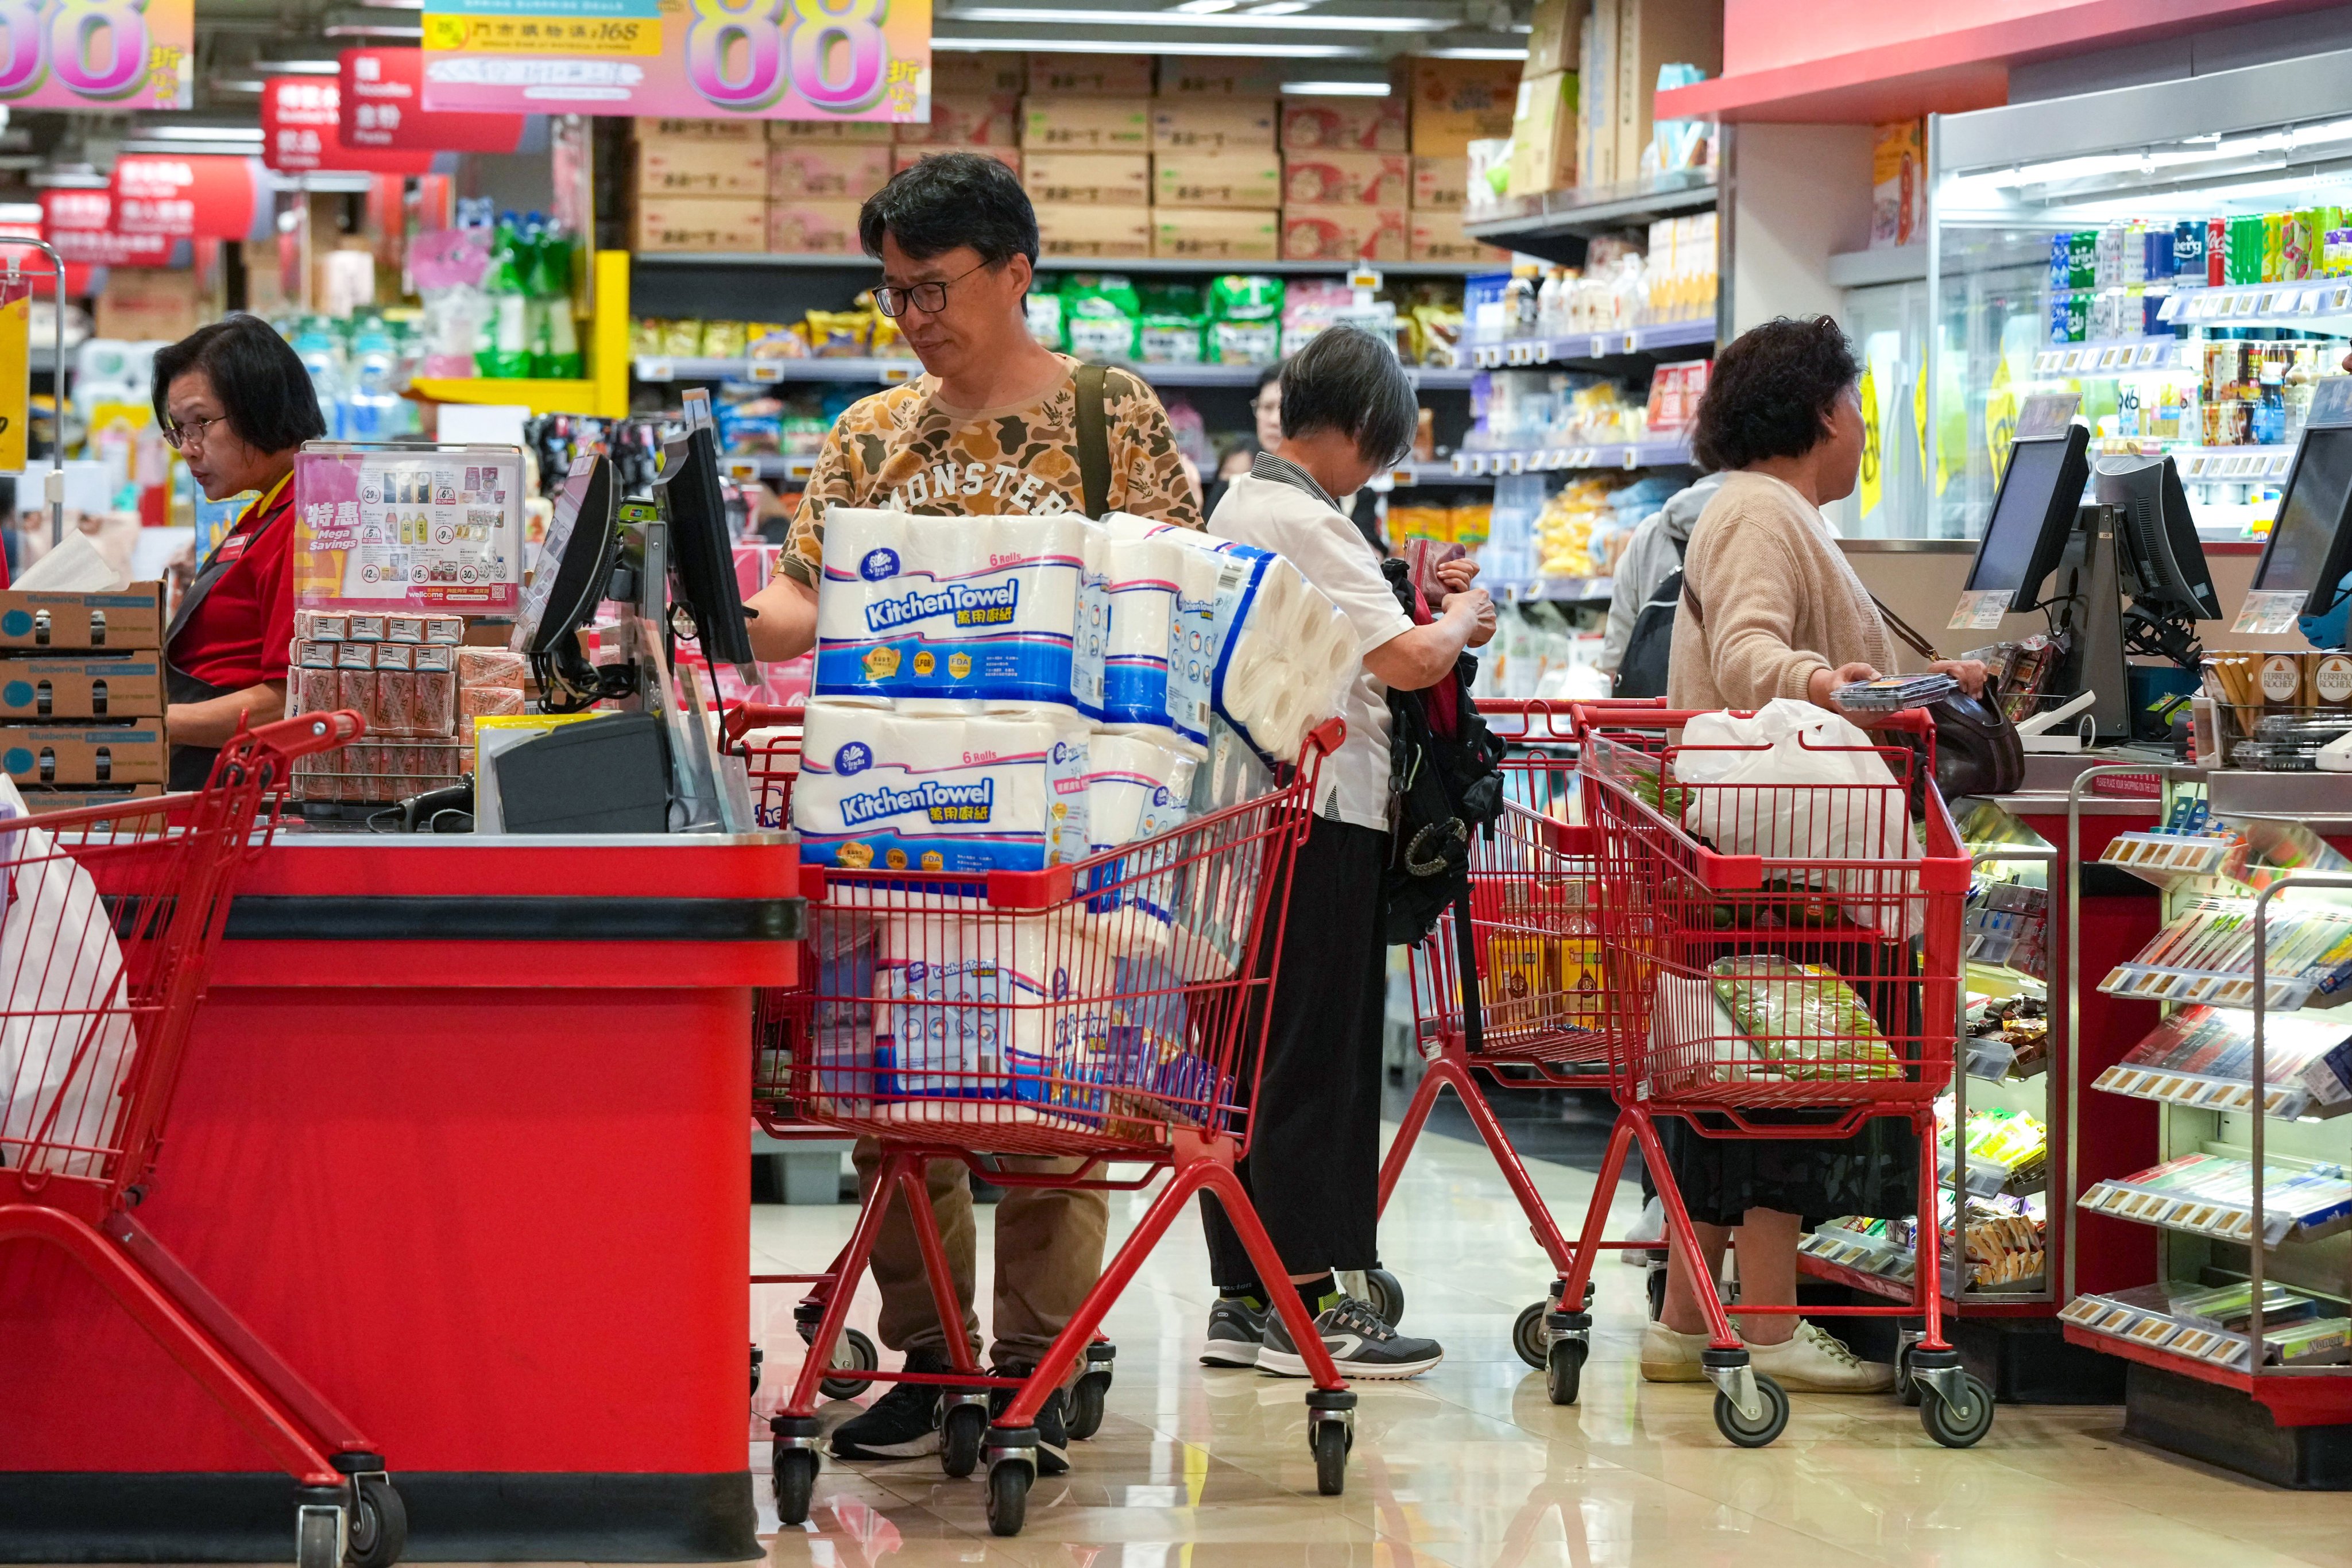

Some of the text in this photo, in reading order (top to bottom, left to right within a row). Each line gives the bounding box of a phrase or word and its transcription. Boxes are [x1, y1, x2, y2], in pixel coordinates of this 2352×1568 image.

[684, 0, 887, 107] 88
[886, 60, 920, 83] 折
[307, 501, 359, 528] 特惠
[318, 529, 350, 539] Mega
[310, 540, 357, 550] Savings
[990, 552, 1022, 567] 6 Rolls
[28, 595, 82, 603] Blueberries
[866, 578, 1017, 630] KitchenTowel
[956, 607, 1013, 625] 萬用廚紙
[2264, 672, 2294, 680] FERRERO
[2319, 672, 2352, 680] FERRERO
[842, 757, 865, 769] Vinda
[963, 750, 997, 764] 6 Rolls
[2096, 777, 2106, 787] PLEASE
[2107, 778, 2115, 788] PLACE
[2124, 780, 2139, 791] SHOPPING
[2139, 782, 2144, 792] ON
[842, 779, 991, 825] KitchenTowel
[929, 806, 988, 822] 萬用廚紙
[923, 855, 941, 864] FDA
